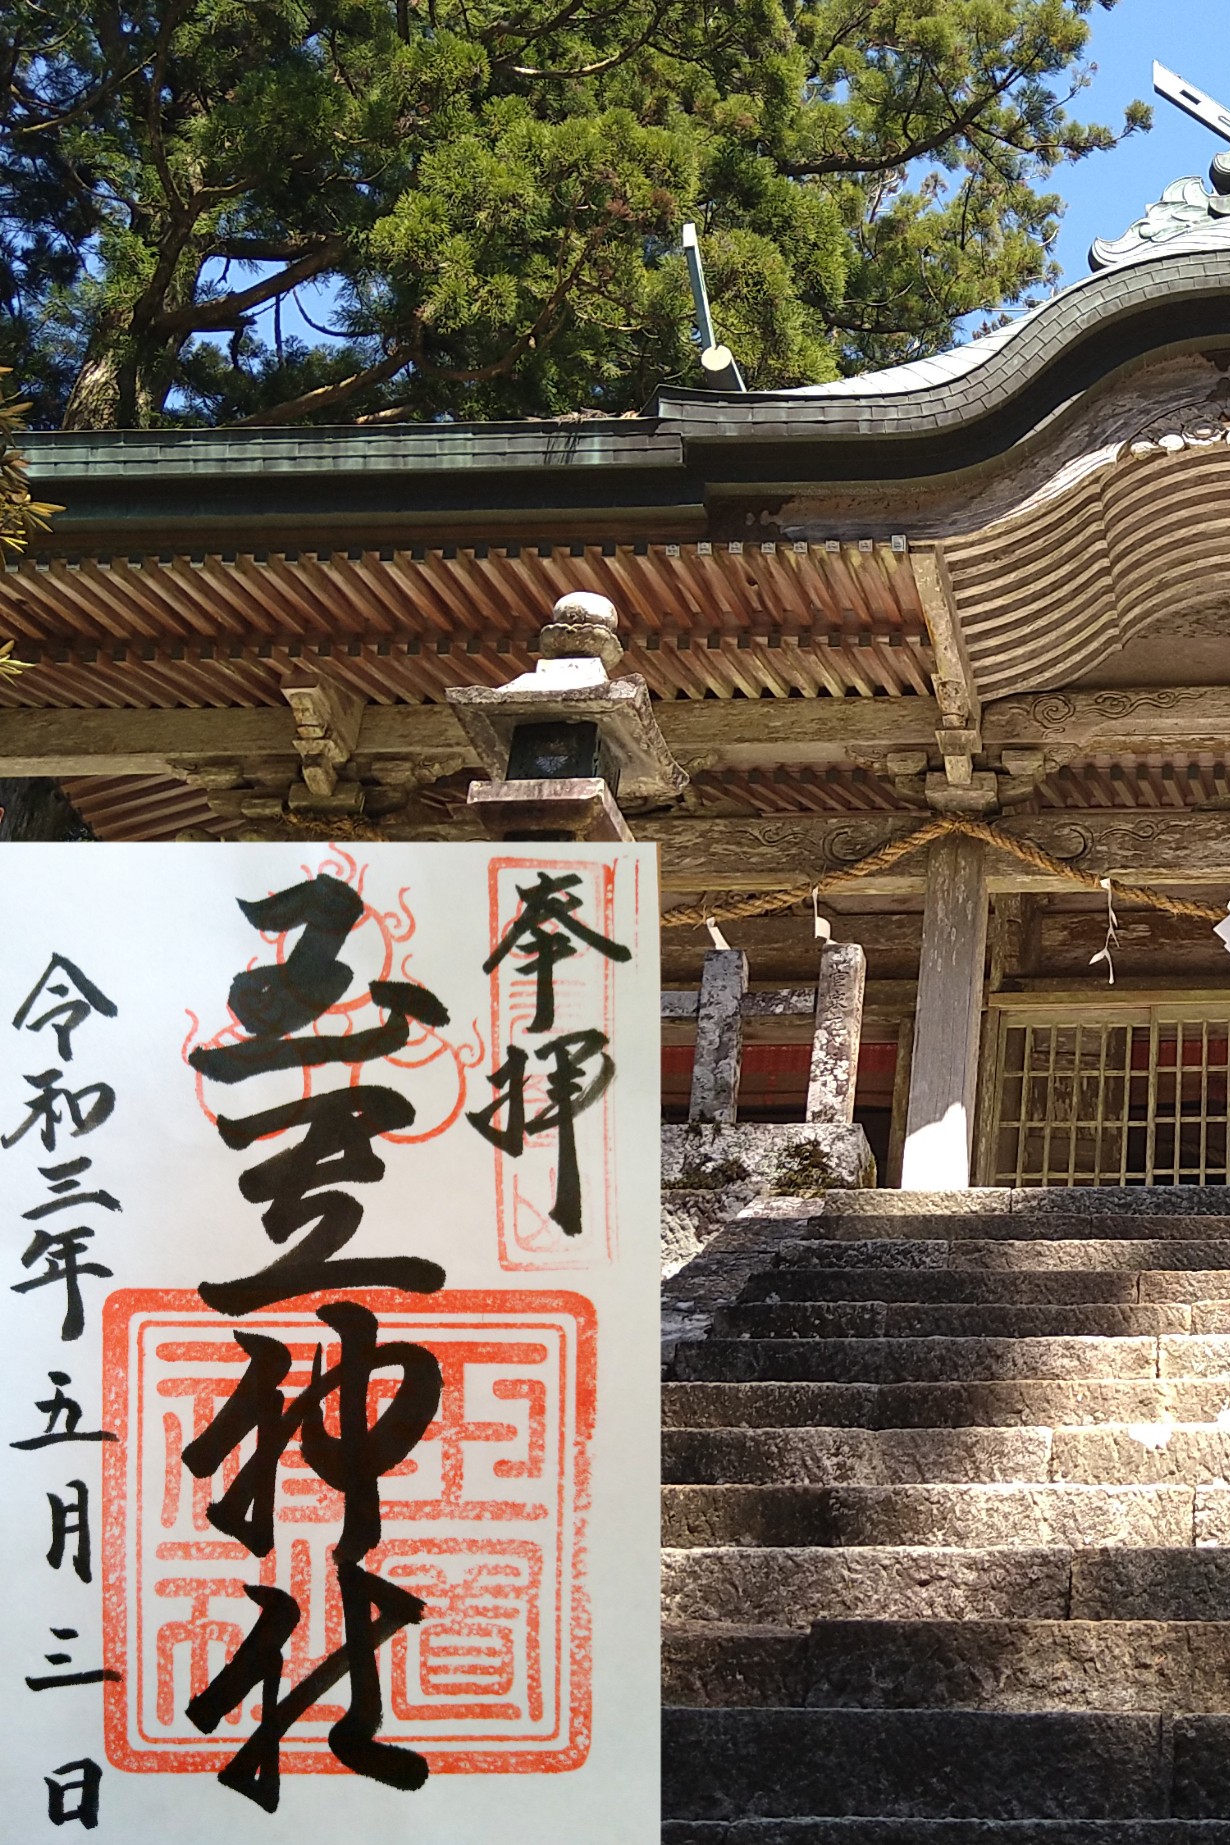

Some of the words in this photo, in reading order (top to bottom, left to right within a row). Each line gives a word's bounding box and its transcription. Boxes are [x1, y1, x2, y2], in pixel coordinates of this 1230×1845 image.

[466, 872, 632, 1237] 奉拝
[1, 953, 122, 1831] 令和三年五月三日
